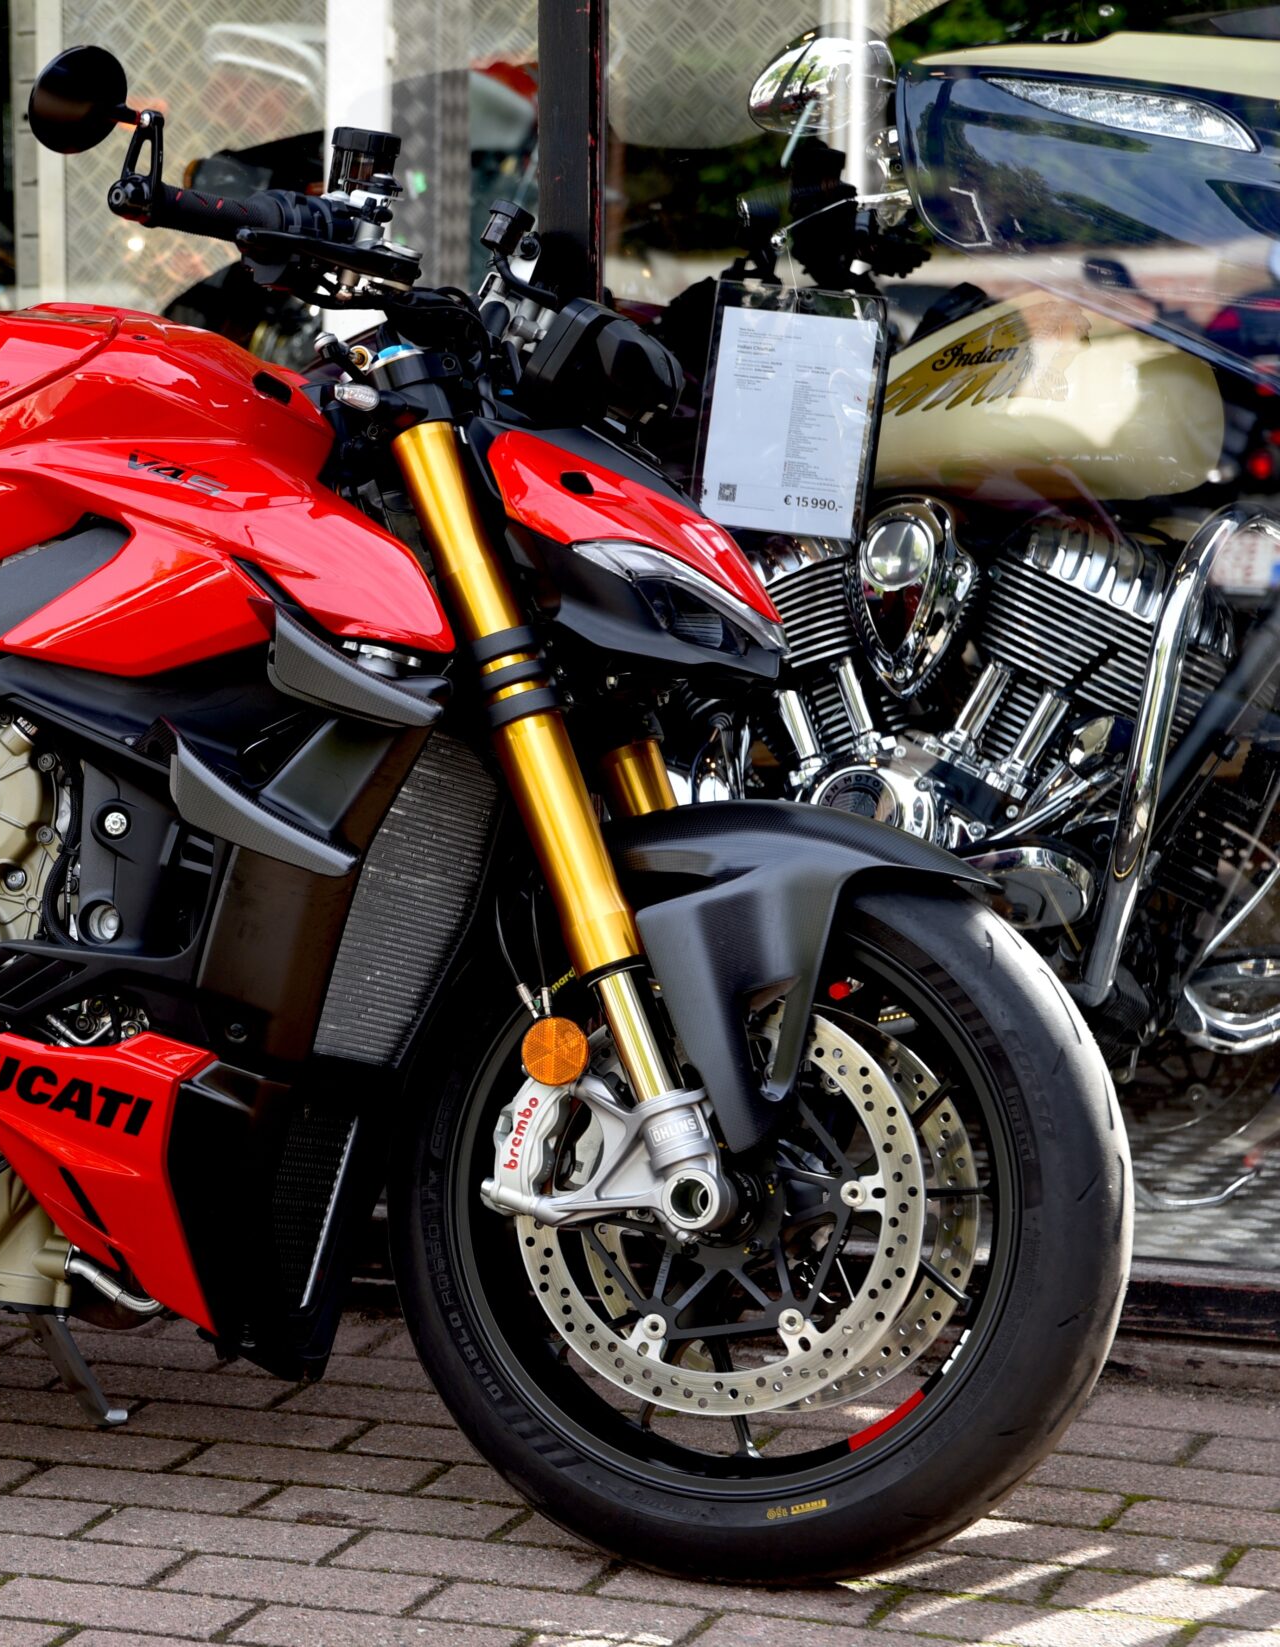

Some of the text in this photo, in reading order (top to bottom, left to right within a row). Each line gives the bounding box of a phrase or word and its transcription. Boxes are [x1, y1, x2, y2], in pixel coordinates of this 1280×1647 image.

[932, 342, 1019, 372] Indian
[784, 495, 792, 506] €
[503, 1096, 540, 1171] brembo
[651, 1118, 698, 1143] ÖHLINS
[448, 1311, 505, 1401] DIABLO
